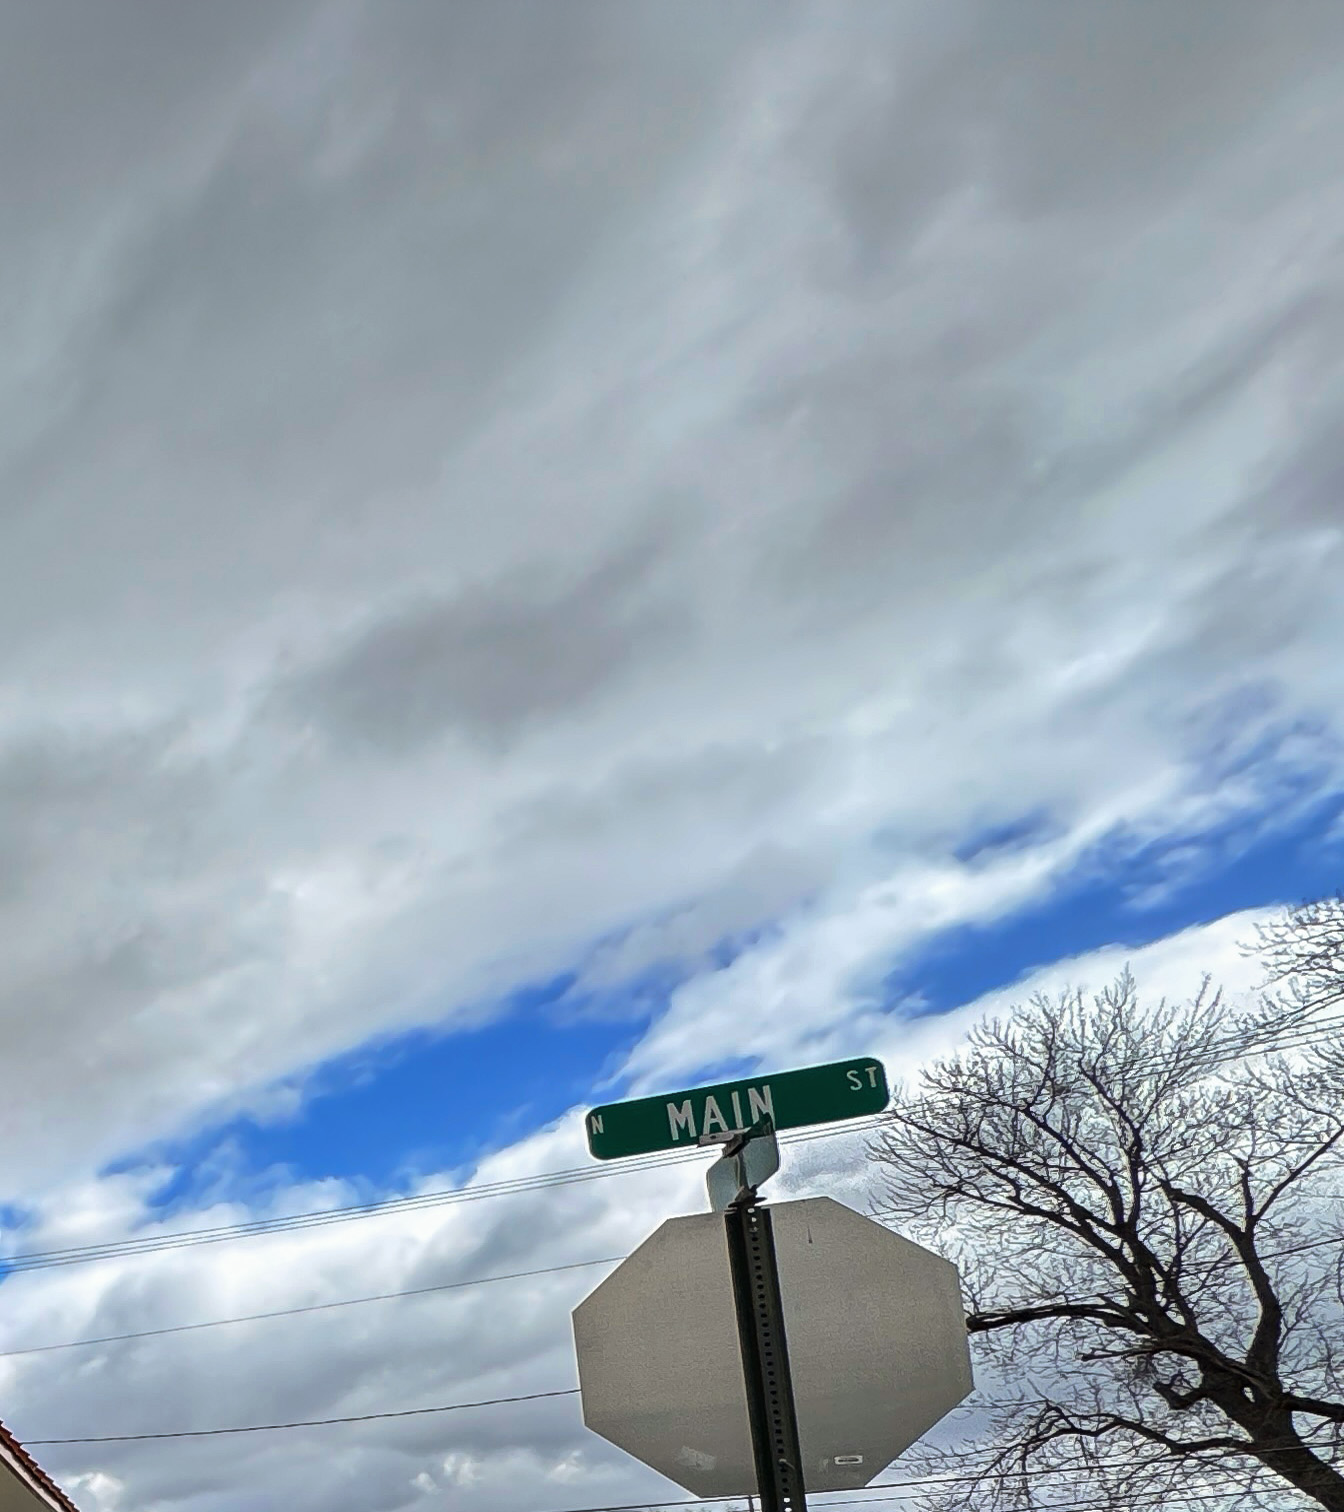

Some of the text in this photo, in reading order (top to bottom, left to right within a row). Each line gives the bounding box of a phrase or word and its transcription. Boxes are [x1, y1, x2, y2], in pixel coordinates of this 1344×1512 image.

[591, 1066, 879, 1142] N MAIN ST
